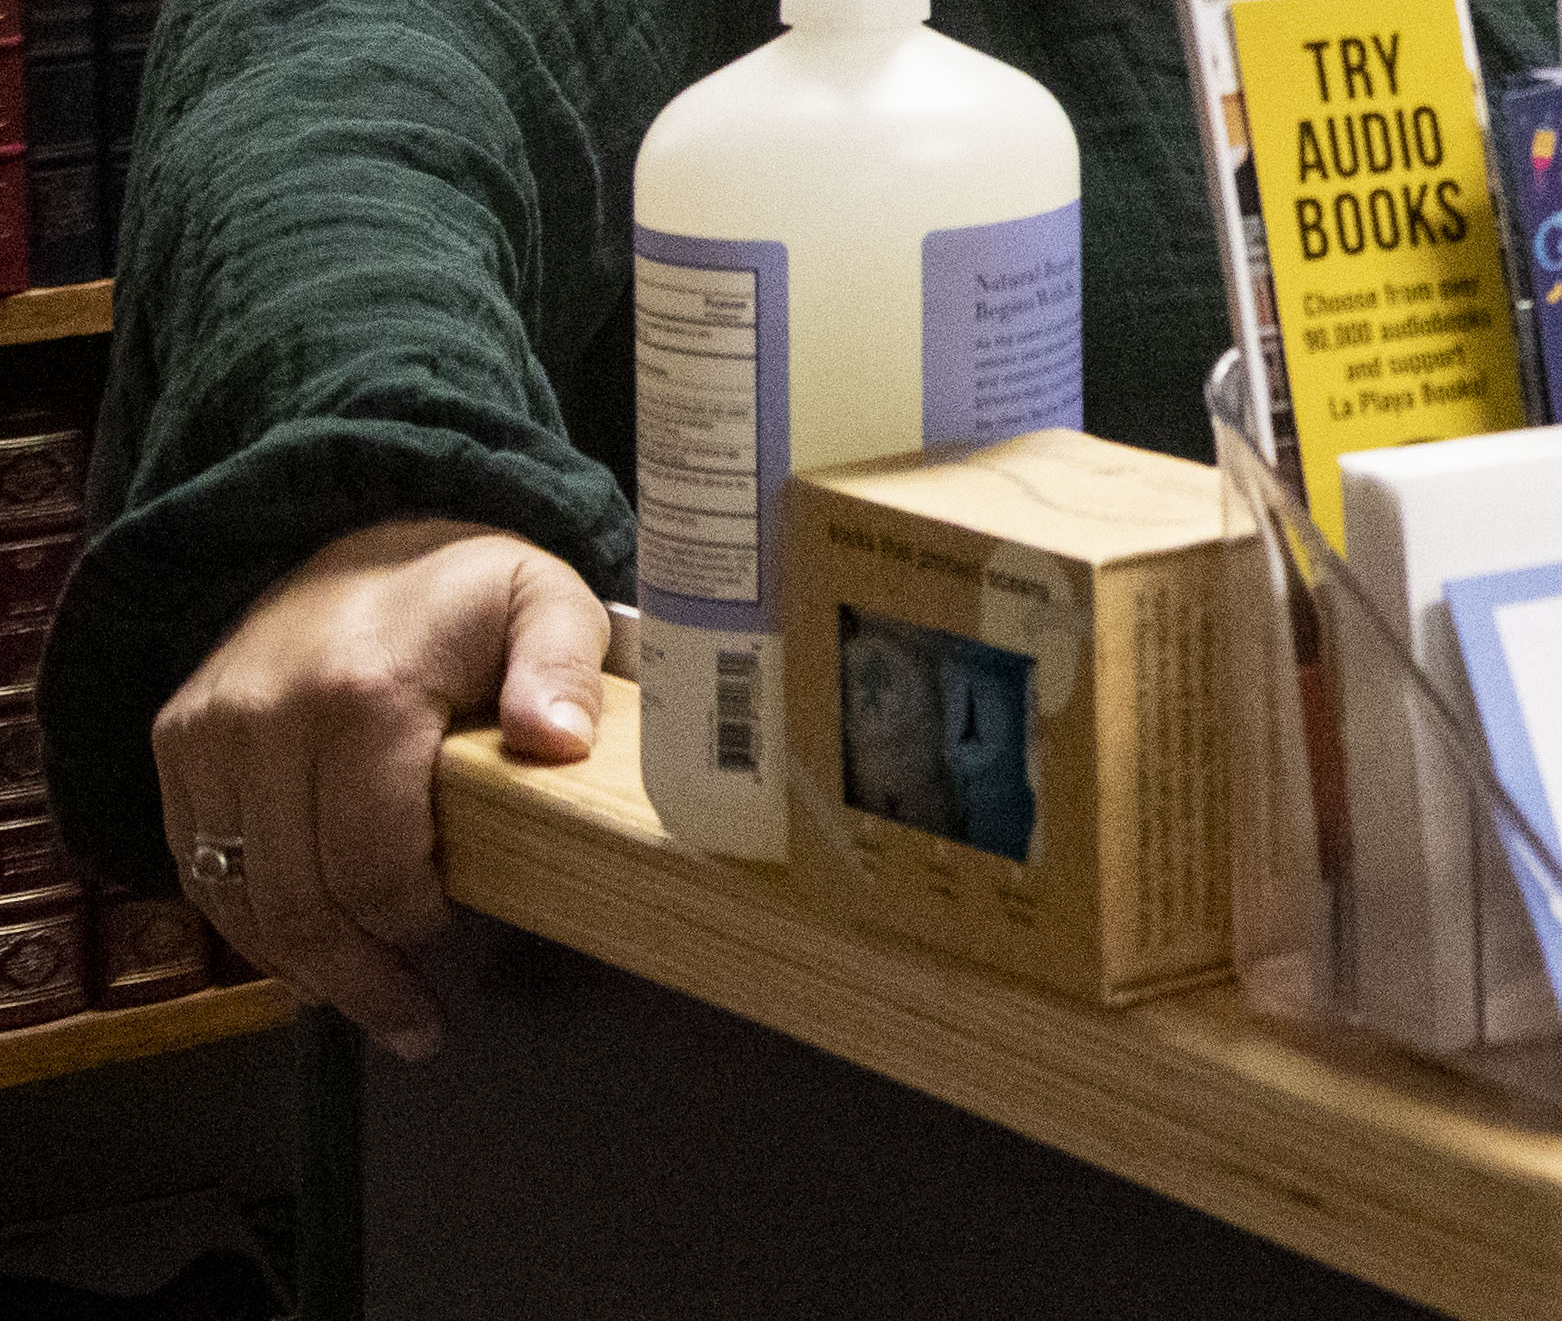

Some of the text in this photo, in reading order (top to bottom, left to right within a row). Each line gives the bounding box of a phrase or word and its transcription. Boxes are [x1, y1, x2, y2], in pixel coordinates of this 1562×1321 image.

[1301, 33, 1402, 105] TRY
[1295, 105, 1446, 185] AUDIO
[1295, 180, 1469, 261] BOOKS
[1303, 278, 1481, 319] Choose from over
[1378, 307, 1494, 341] audiobooks
[1345, 345, 1468, 383] and support
[1330, 397, 1354, 422] La
[1358, 387, 1414, 417] Playa
